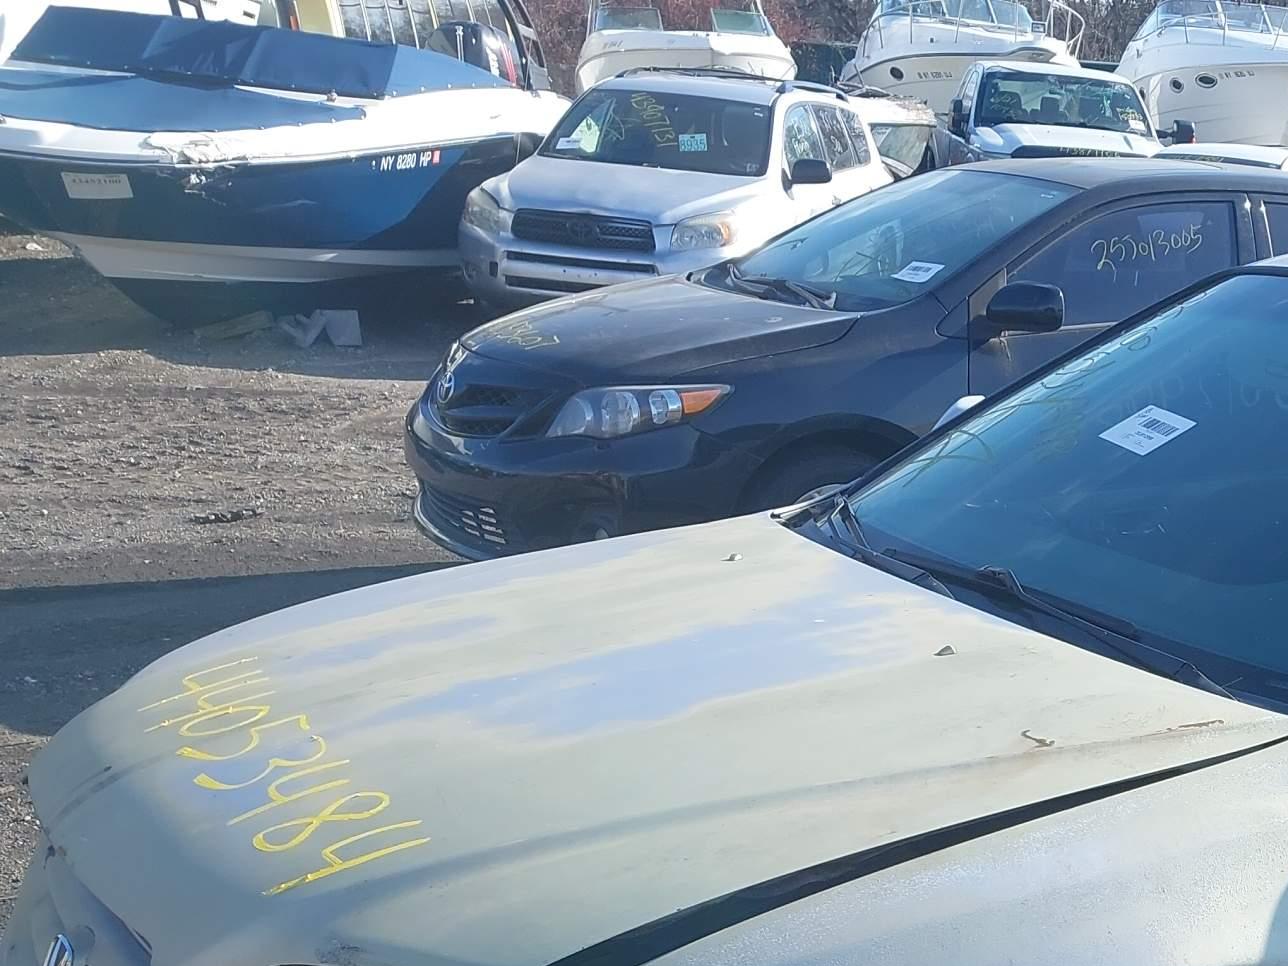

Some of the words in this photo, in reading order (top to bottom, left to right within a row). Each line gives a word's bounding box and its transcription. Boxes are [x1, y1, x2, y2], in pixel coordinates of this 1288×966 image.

[380, 155, 395, 171] NY
[396, 152, 417, 170] 8280
[419, 151, 432, 168] HP
[137, 656, 431, 895] 44053484
